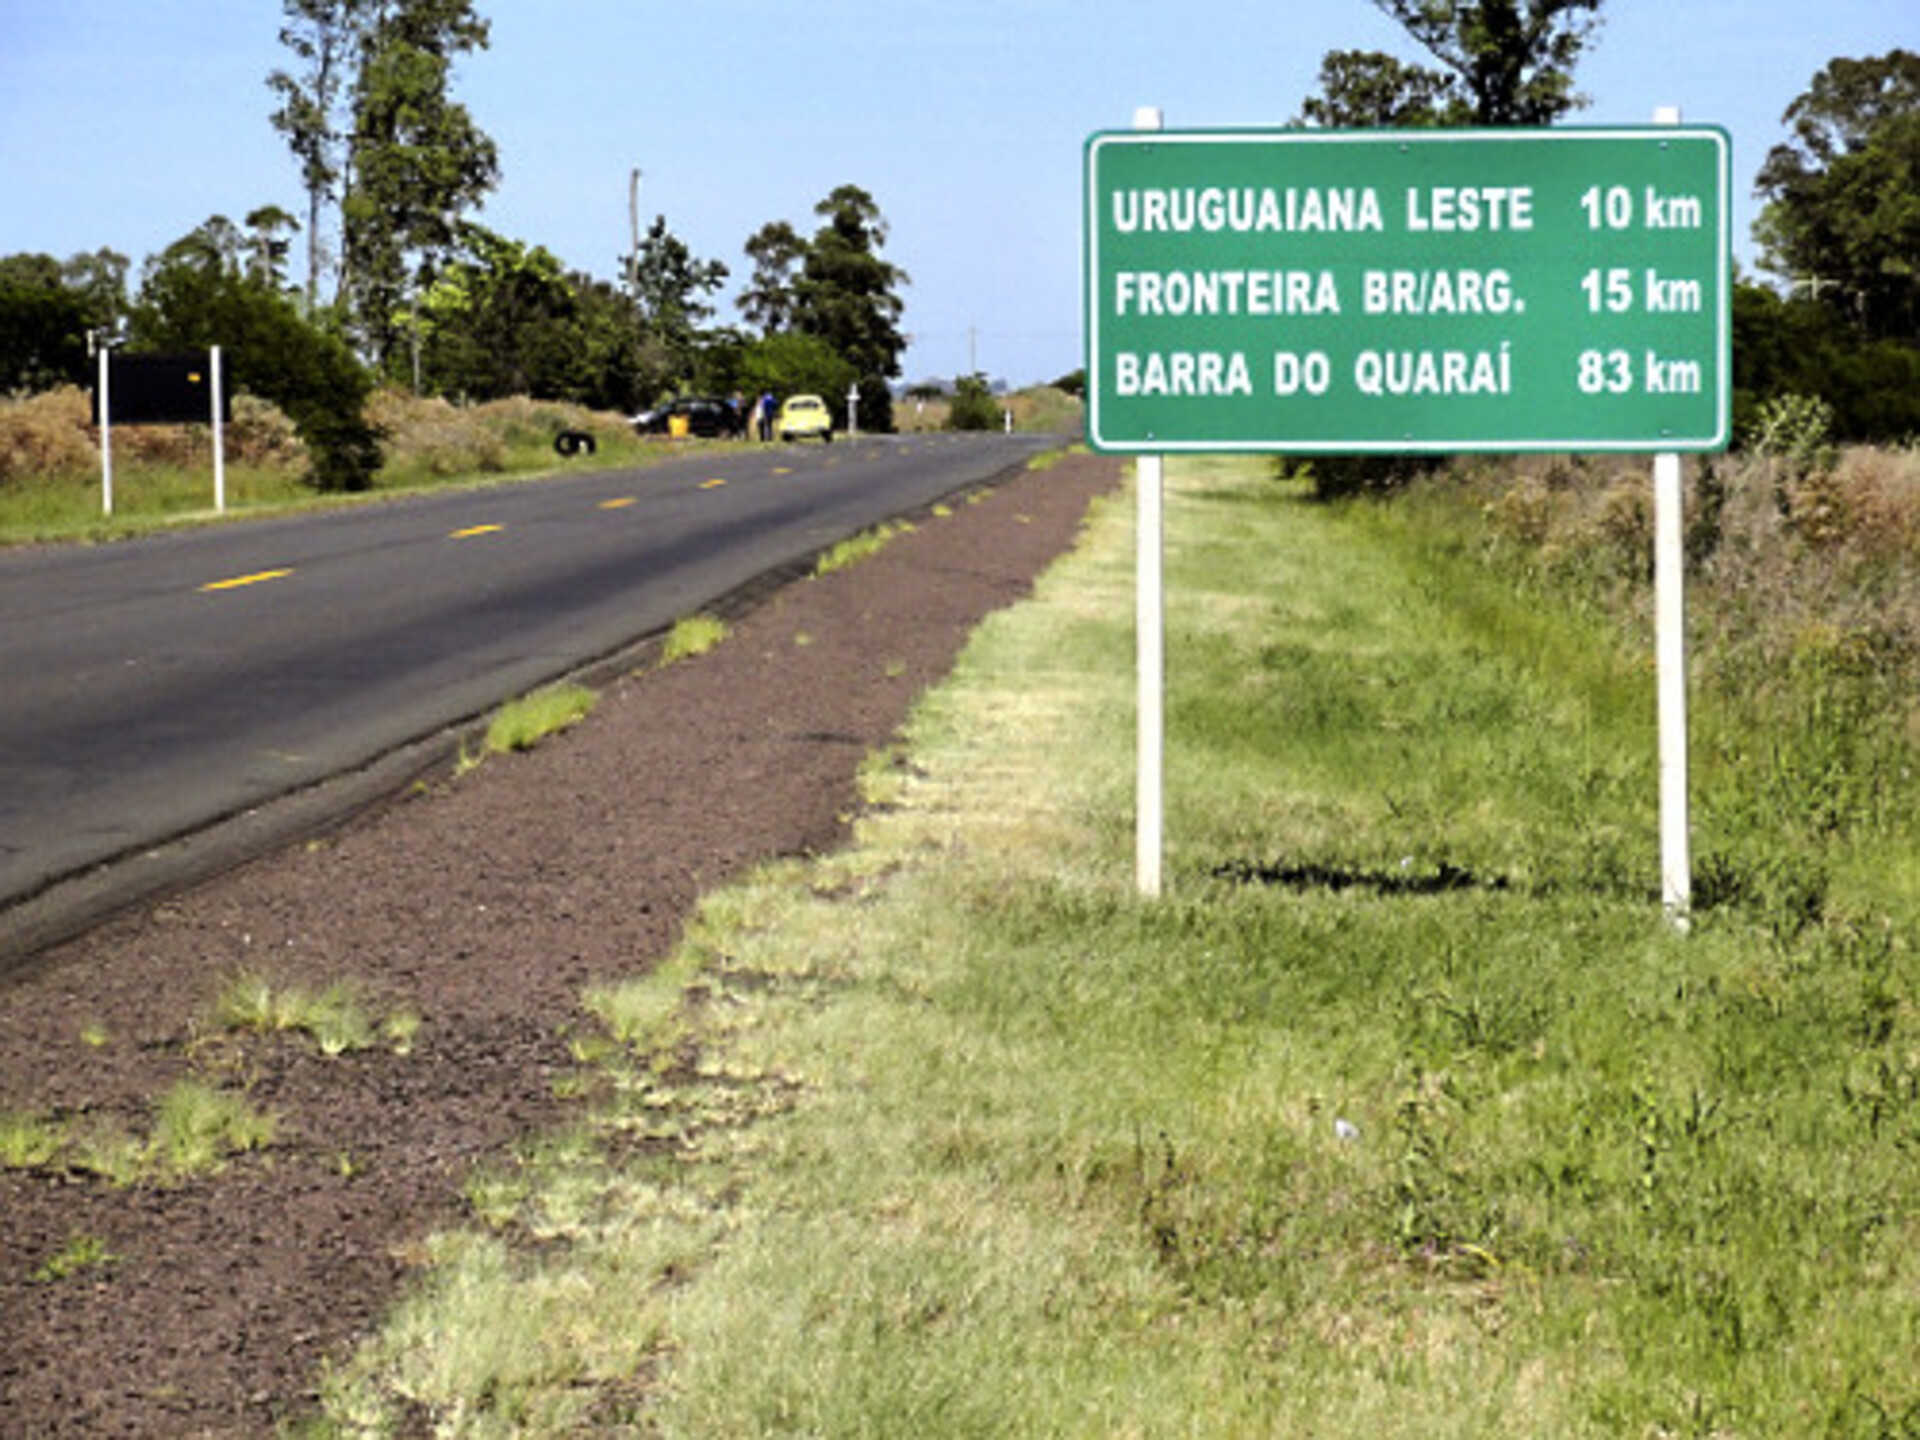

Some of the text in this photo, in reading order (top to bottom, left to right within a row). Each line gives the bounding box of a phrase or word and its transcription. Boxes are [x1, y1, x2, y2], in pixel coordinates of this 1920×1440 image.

[1112, 185, 1702, 233] URUGUAIANA LESTE 10 km
[1116, 268, 1702, 316] FRONTEIRA BR/ARG. 15 km
[1116, 340, 1702, 396] BARRA DO QUARAÍ 83 km
